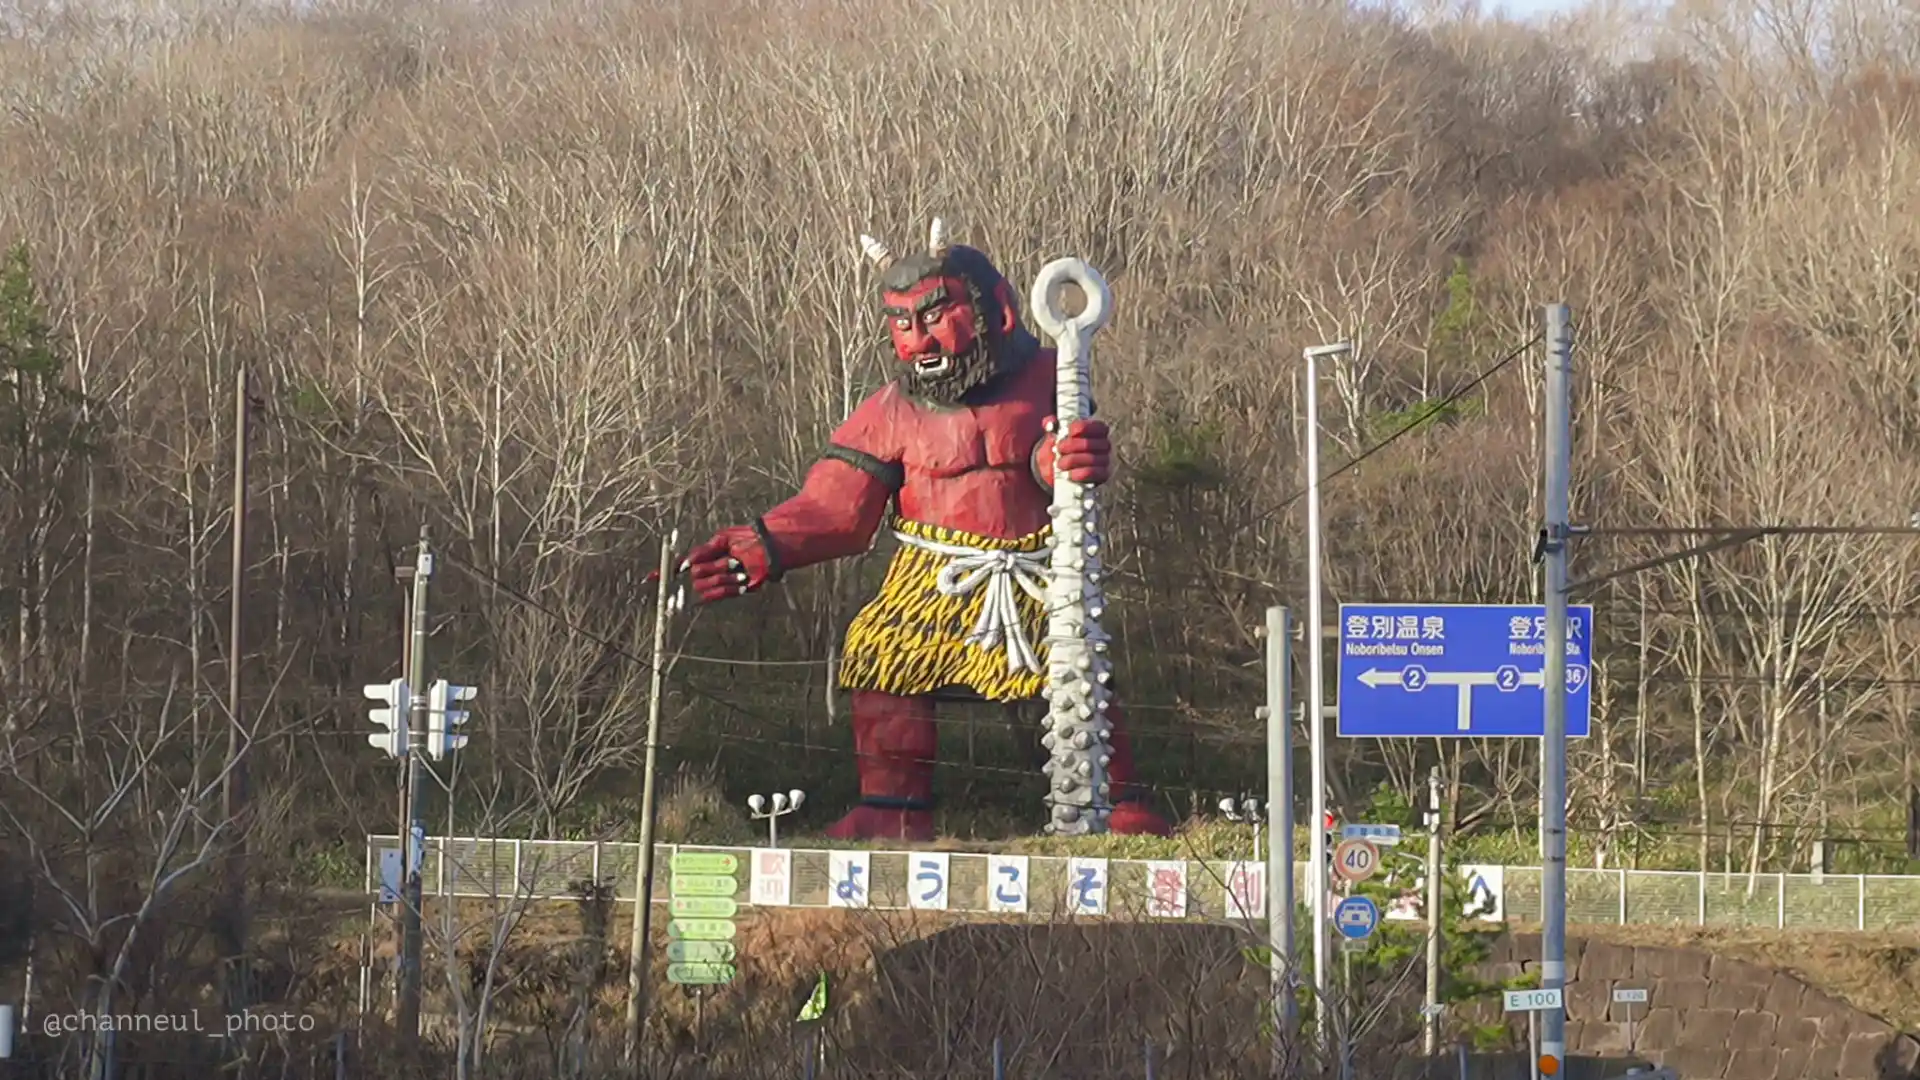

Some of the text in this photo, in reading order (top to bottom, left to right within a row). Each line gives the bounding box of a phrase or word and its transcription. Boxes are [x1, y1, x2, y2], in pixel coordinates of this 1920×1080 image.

[1346, 615, 1445, 639] 登別温泉
[1346, 641, 1444, 655] Noboribetsu Onsen
[1509, 642, 1546, 655] Noborib
[1408, 670, 1420, 686] 2
[1502, 670, 1514, 687] 2
[1345, 849, 1369, 868] 40
[1510, 992, 1556, 1007] E 100
